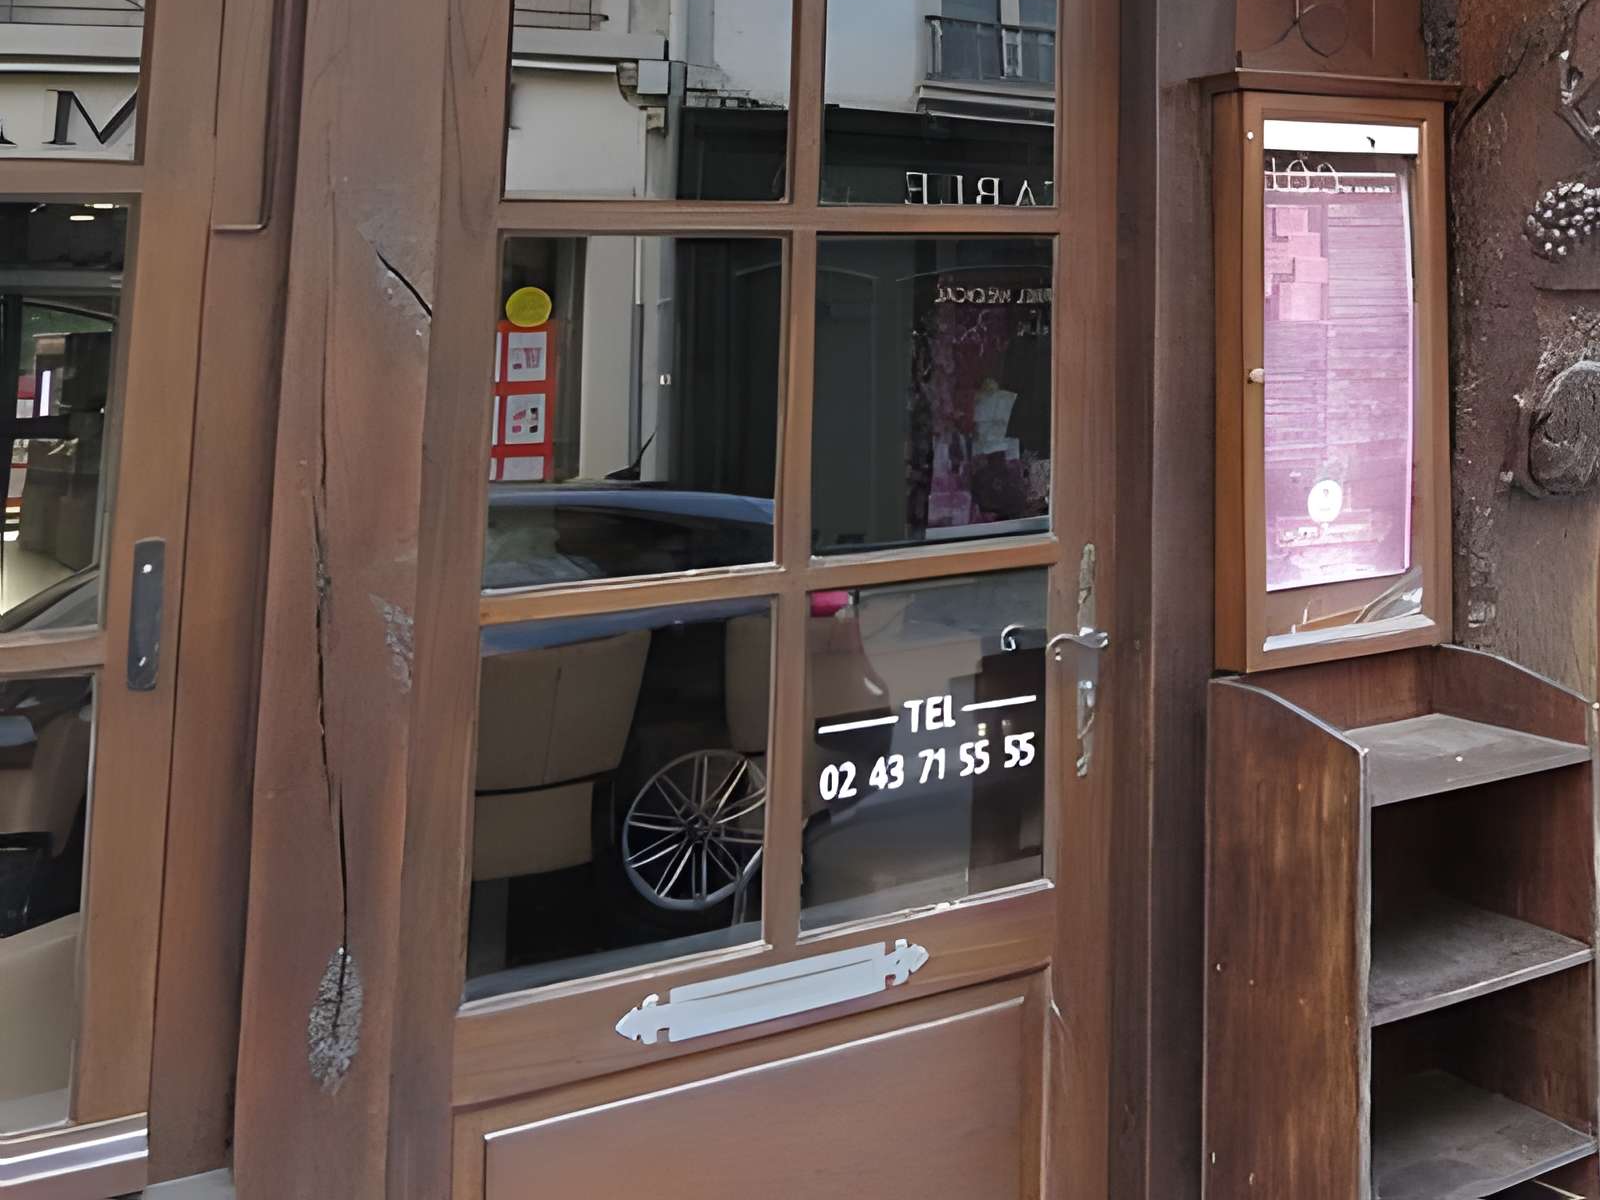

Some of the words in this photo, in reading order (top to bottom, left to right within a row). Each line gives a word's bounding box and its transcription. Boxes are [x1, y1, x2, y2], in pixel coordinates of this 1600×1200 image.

[903, 694, 957, 734] TEL
[818, 761, 858, 801] 02
[868, 753, 905, 790] 43
[917, 747, 947, 785] 71
[959, 738, 990, 777] 55
[1003, 731, 1036, 769] 55
